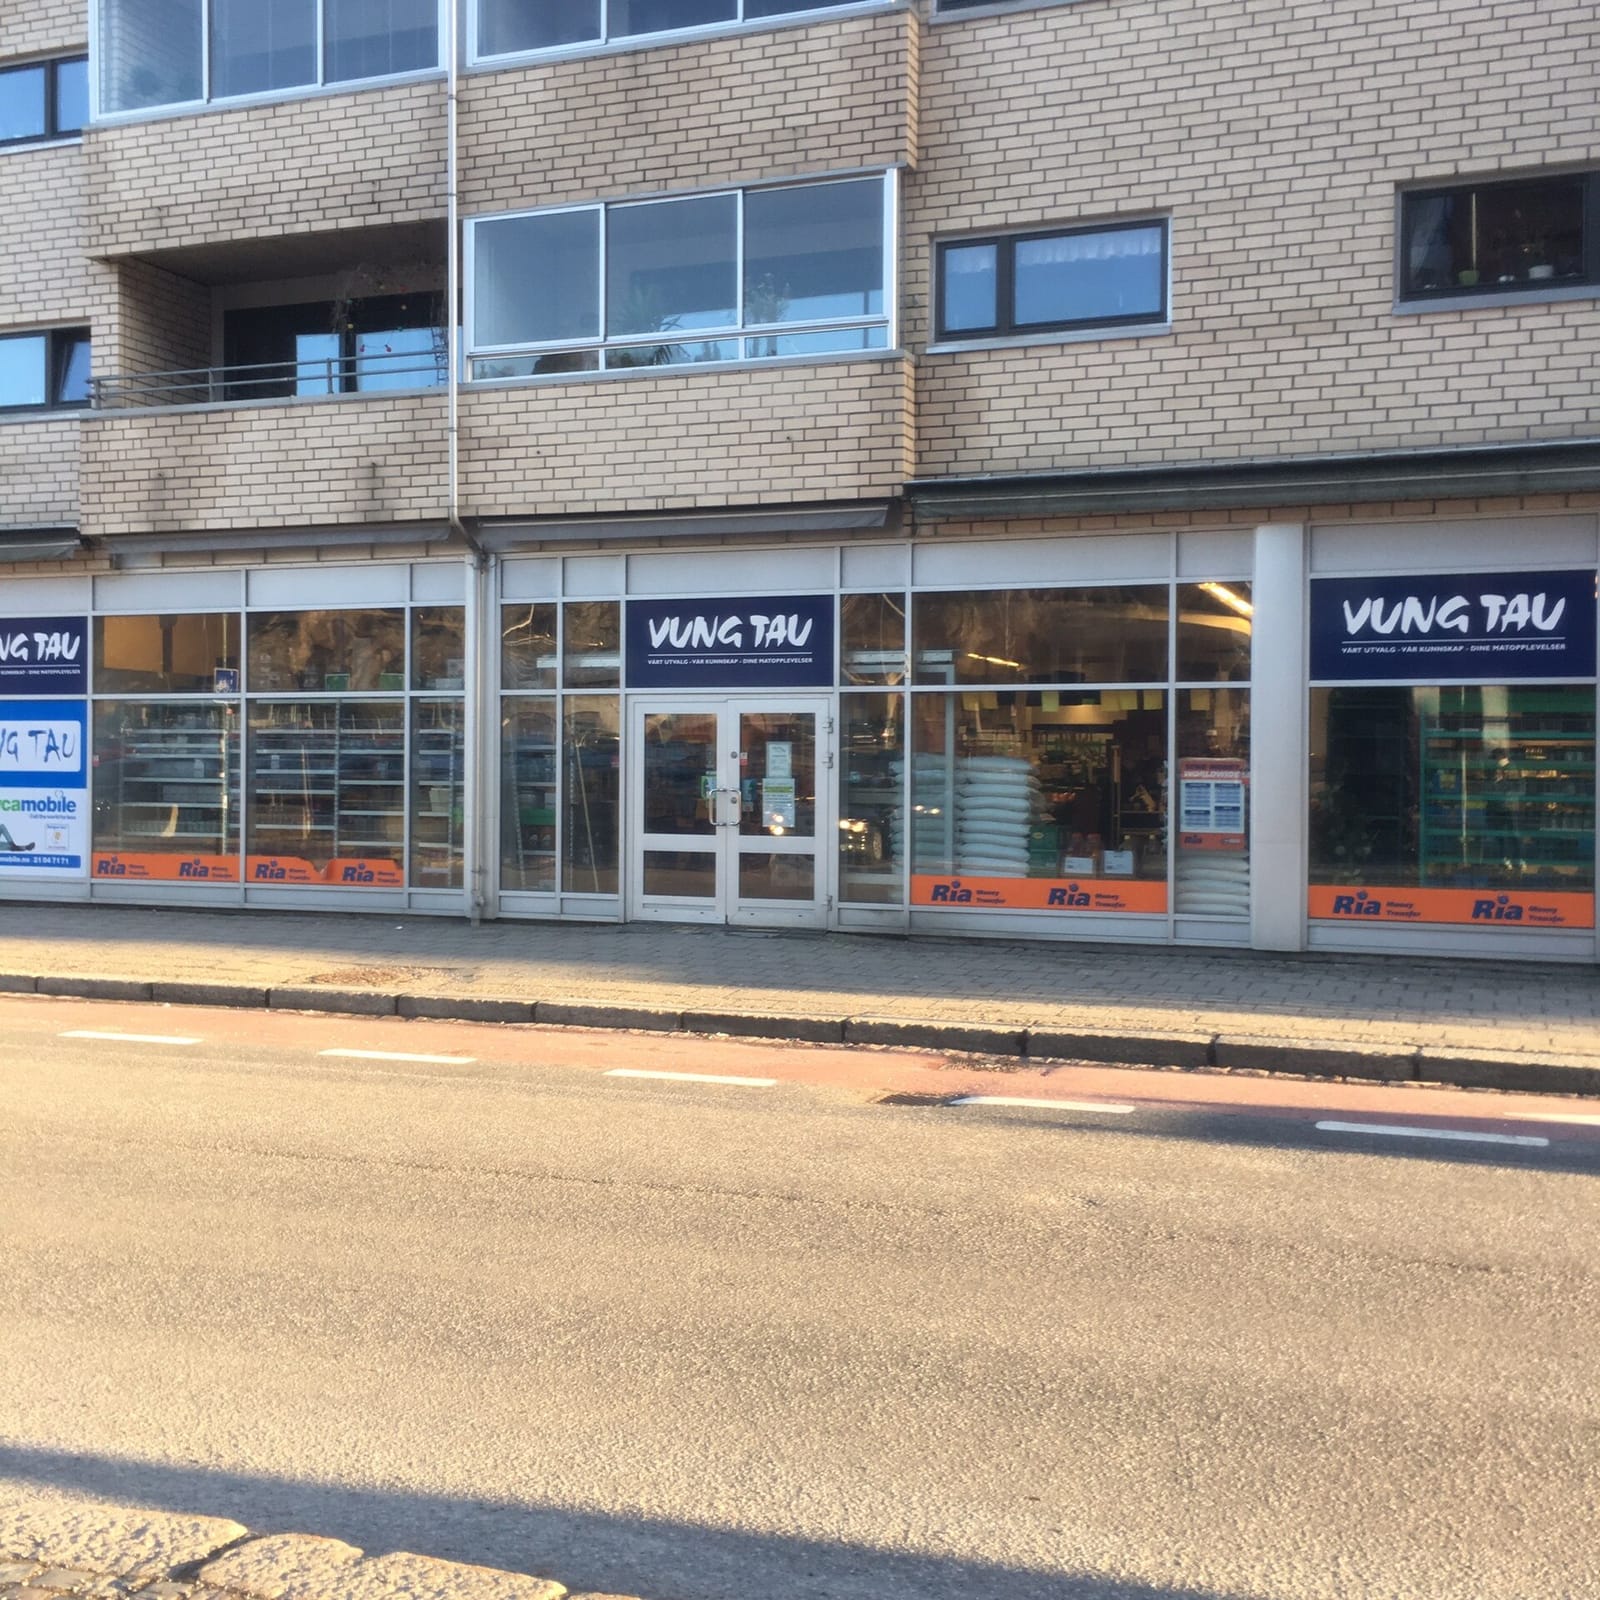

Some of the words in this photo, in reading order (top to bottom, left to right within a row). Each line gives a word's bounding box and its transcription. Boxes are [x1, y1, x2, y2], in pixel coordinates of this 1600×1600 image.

[1343, 595, 1470, 635] VUNG
[1480, 593, 1566, 632] TAU
[648, 615, 743, 648] VUNG
[750, 614, 813, 648] TAU
[33, 632, 80, 661] TAU
[28, 728, 76, 763] TAU
[0, 796, 77, 813] camobile
[97, 856, 126, 875] Ria
[179, 858, 209, 877] Ria
[255, 860, 286, 879] Ria
[342, 863, 375, 882] Ria
[931, 880, 972, 902] Ria
[1048, 884, 1091, 906] Ria
[1332, 891, 1381, 915] Ria
[1472, 895, 1523, 920] Ria
